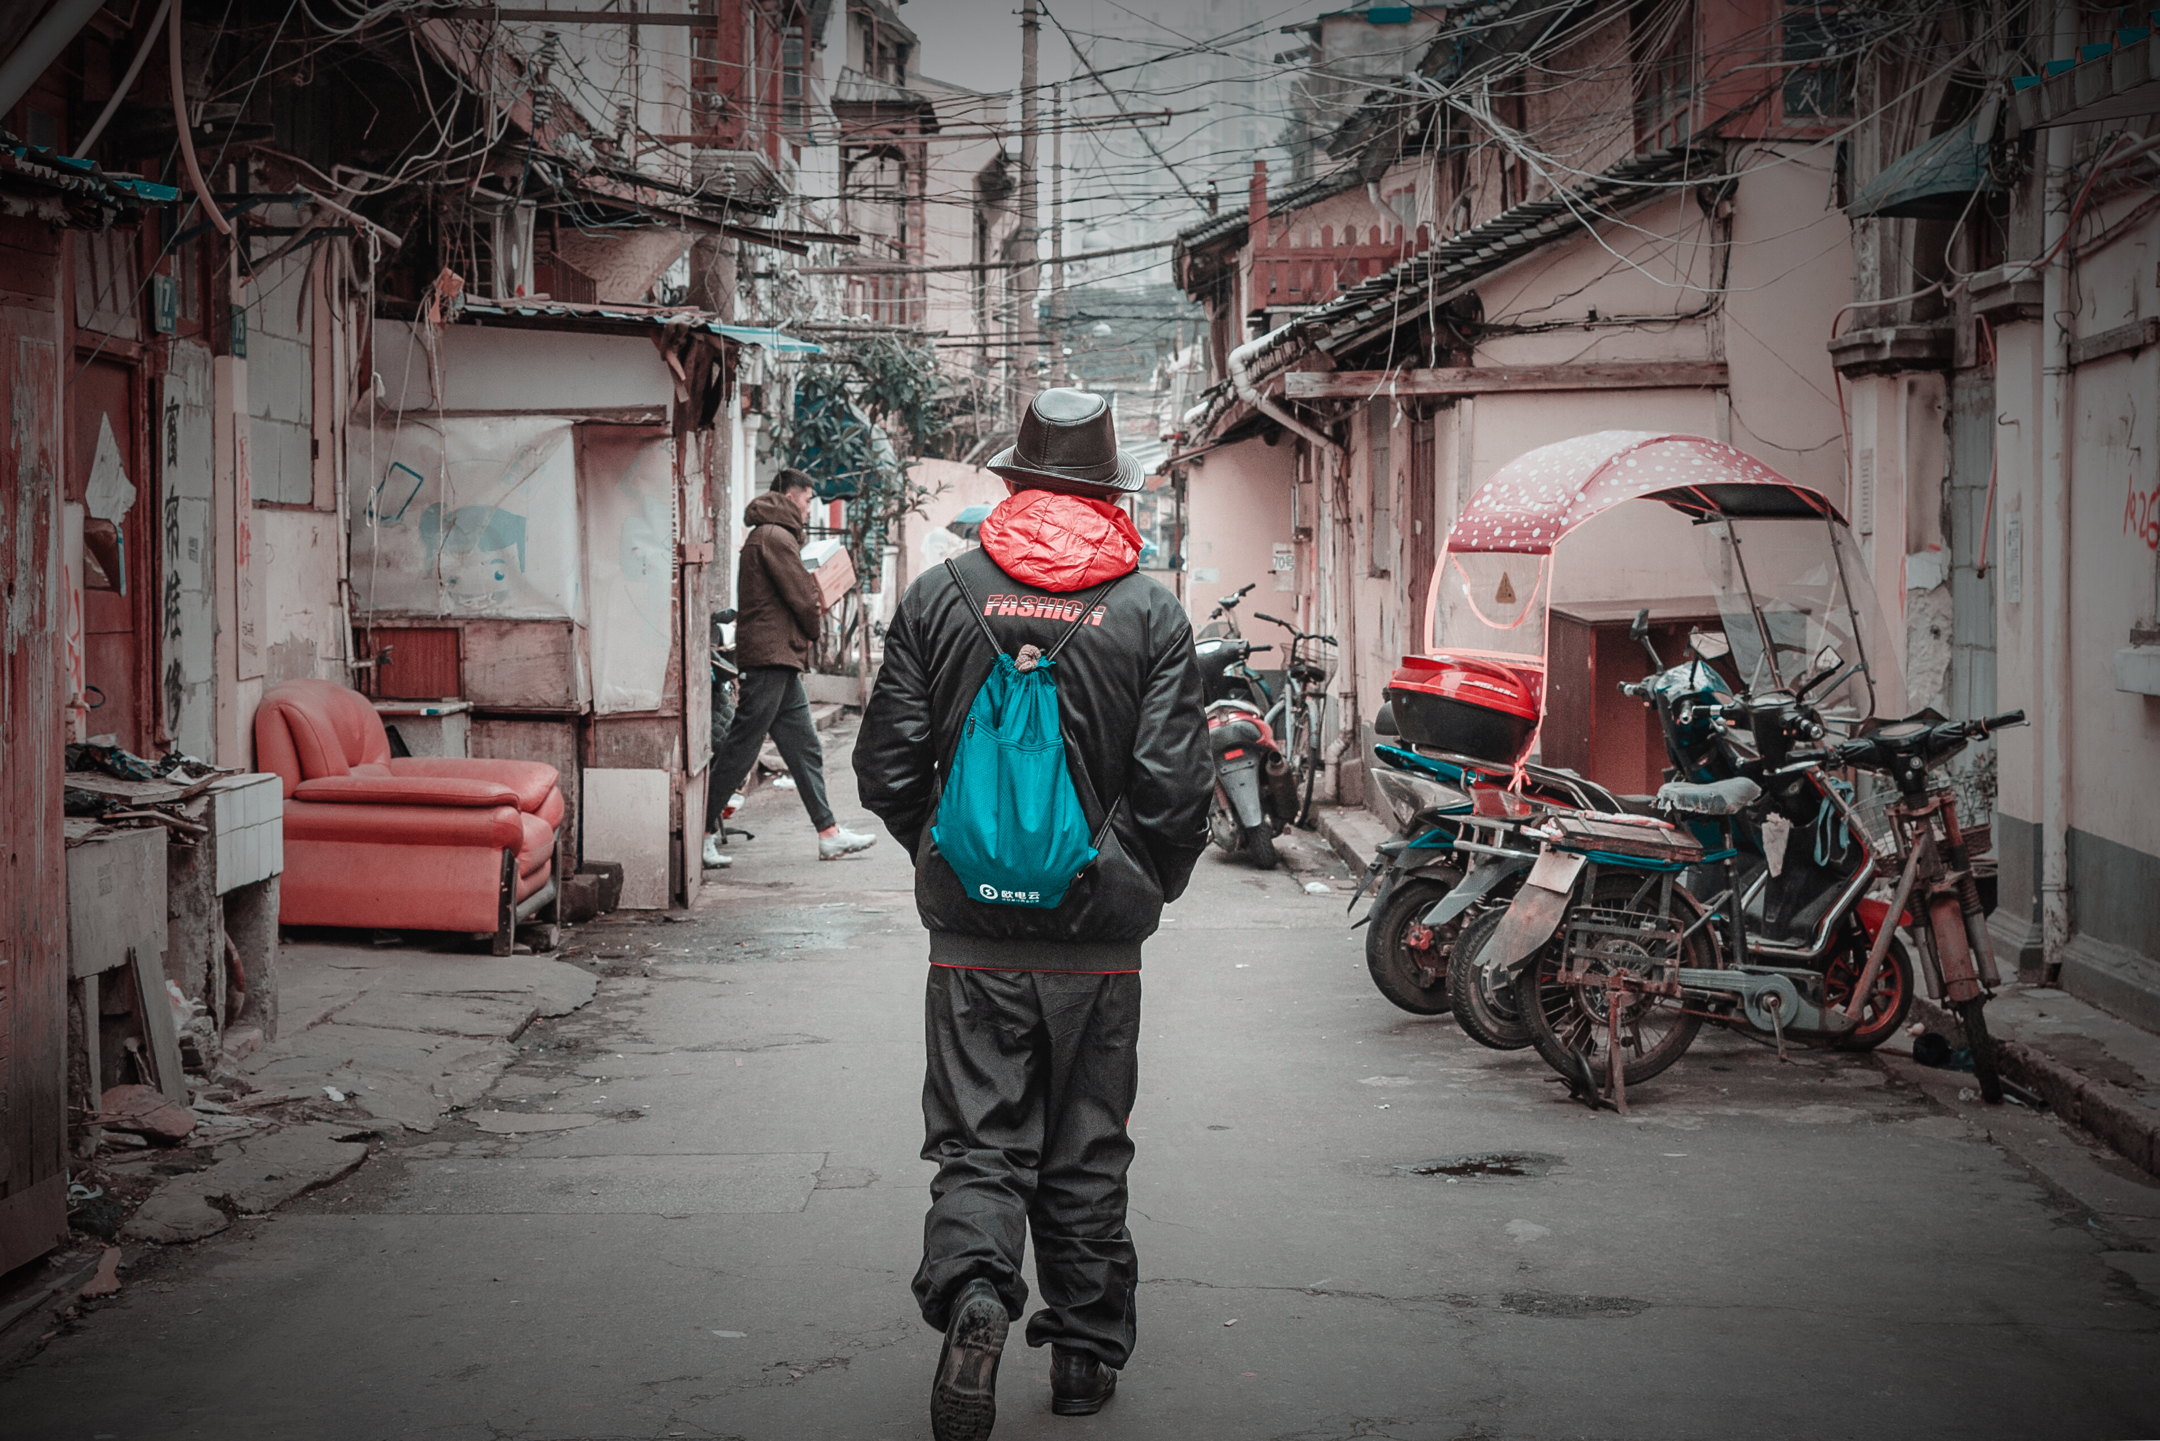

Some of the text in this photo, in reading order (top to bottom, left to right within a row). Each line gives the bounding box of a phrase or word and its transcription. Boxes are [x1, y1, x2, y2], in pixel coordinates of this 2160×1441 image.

[1273, 554, 1295, 571] 70号
[1001, 889, 1041, 900] 欧电云
